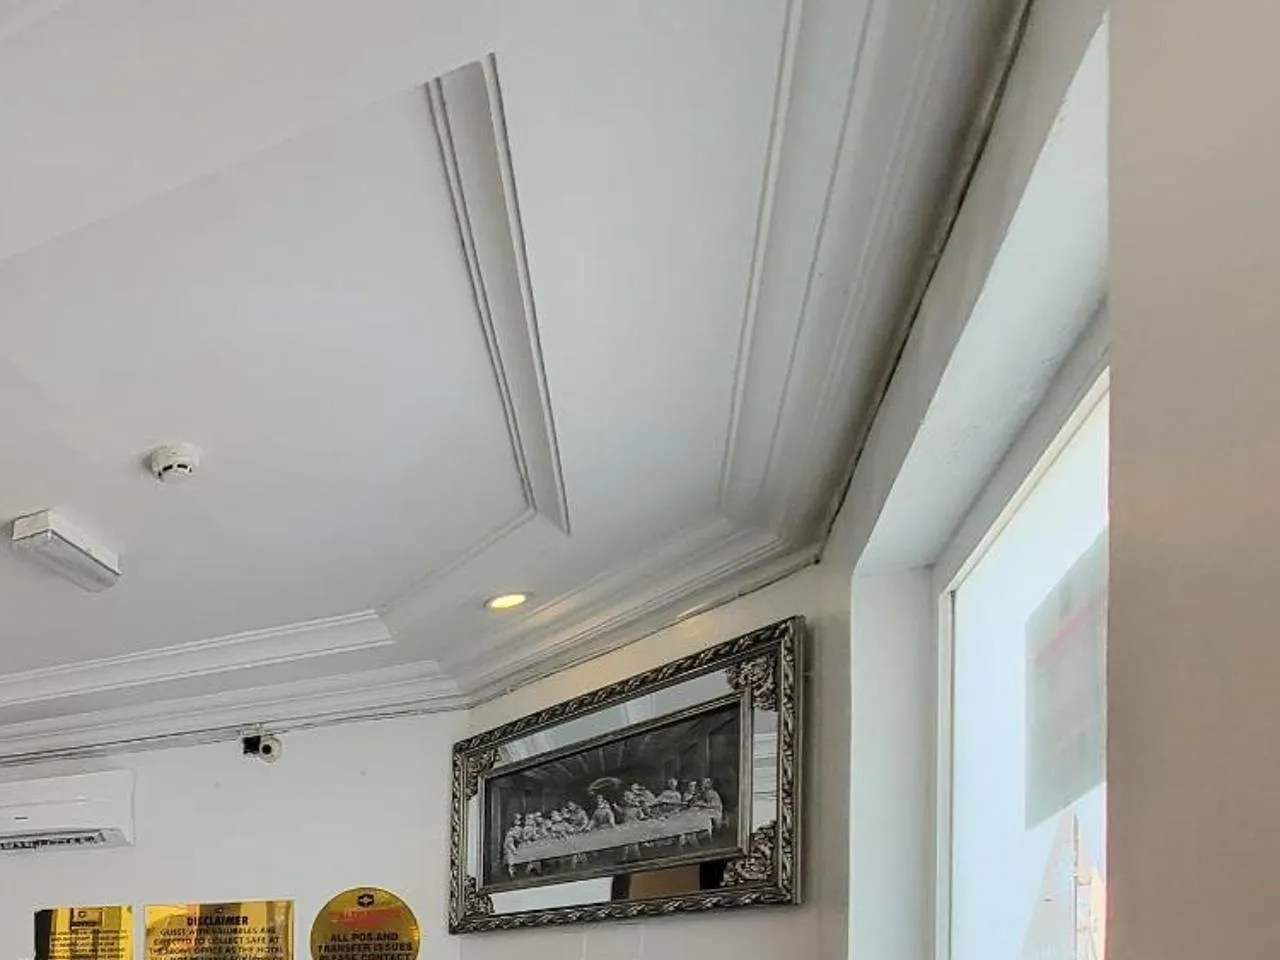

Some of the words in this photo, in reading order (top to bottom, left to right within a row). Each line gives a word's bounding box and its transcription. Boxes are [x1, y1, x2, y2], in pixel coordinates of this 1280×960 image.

[187, 916, 249, 926] DISCLAIMER
[330, 932, 348, 942] ALL
[351, 932, 373, 941] POS
[376, 932, 399, 941] AND
[373, 942, 413, 952] ISSUES
